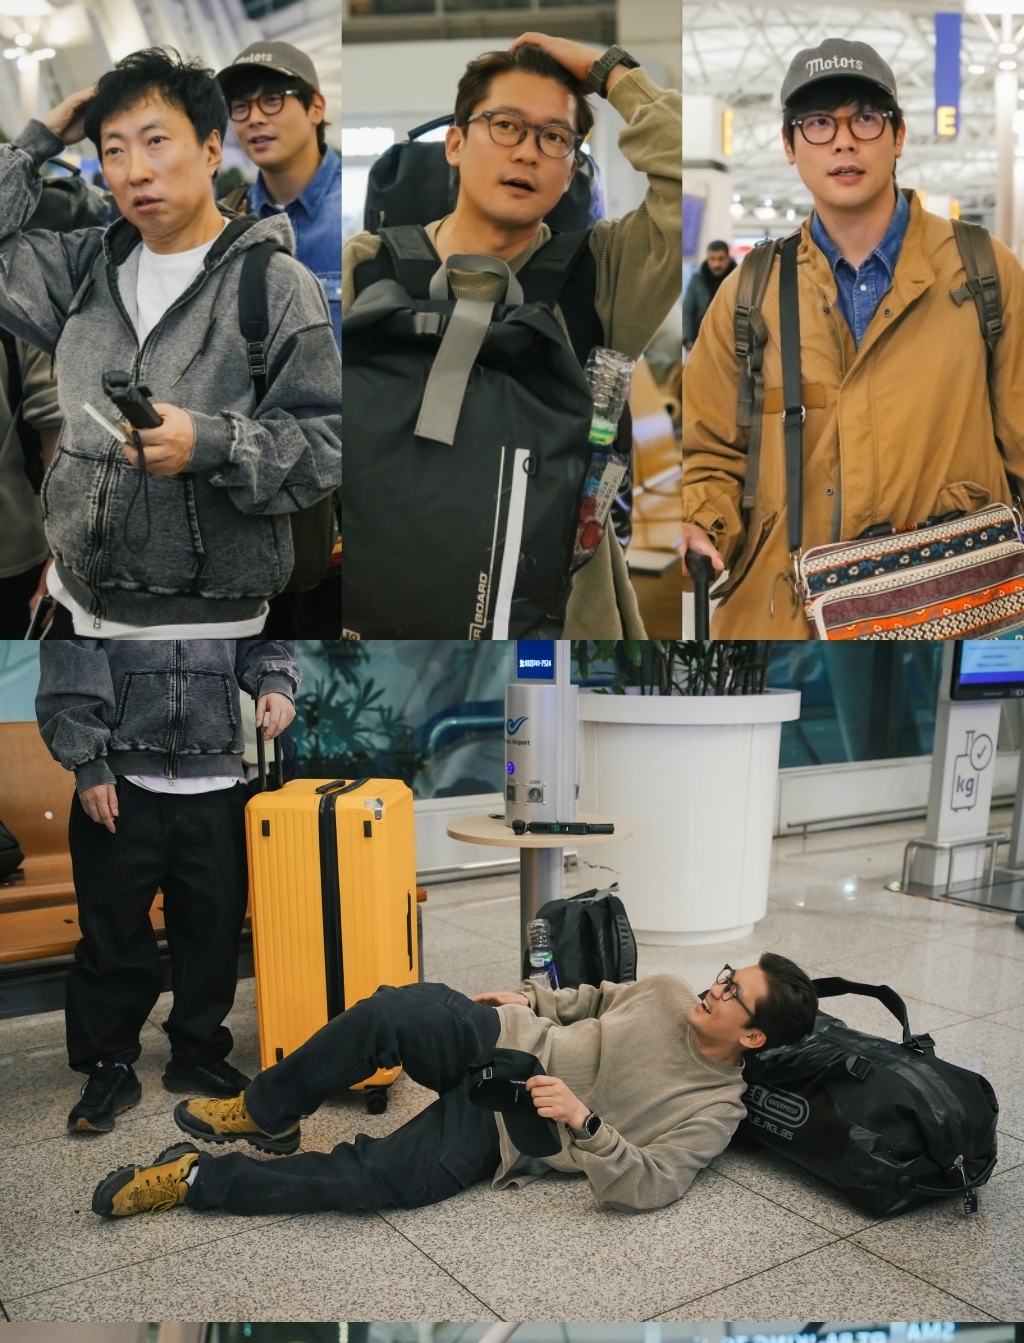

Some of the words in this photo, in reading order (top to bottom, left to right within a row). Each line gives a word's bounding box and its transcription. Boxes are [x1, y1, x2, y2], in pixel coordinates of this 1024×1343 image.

[806, 55, 864, 77] Motors
[937, 106, 956, 136] E
[475, 572, 488, 623] BOARD
[957, 775, 974, 797] kg
[768, 1098, 799, 1115] WATERPROOF
